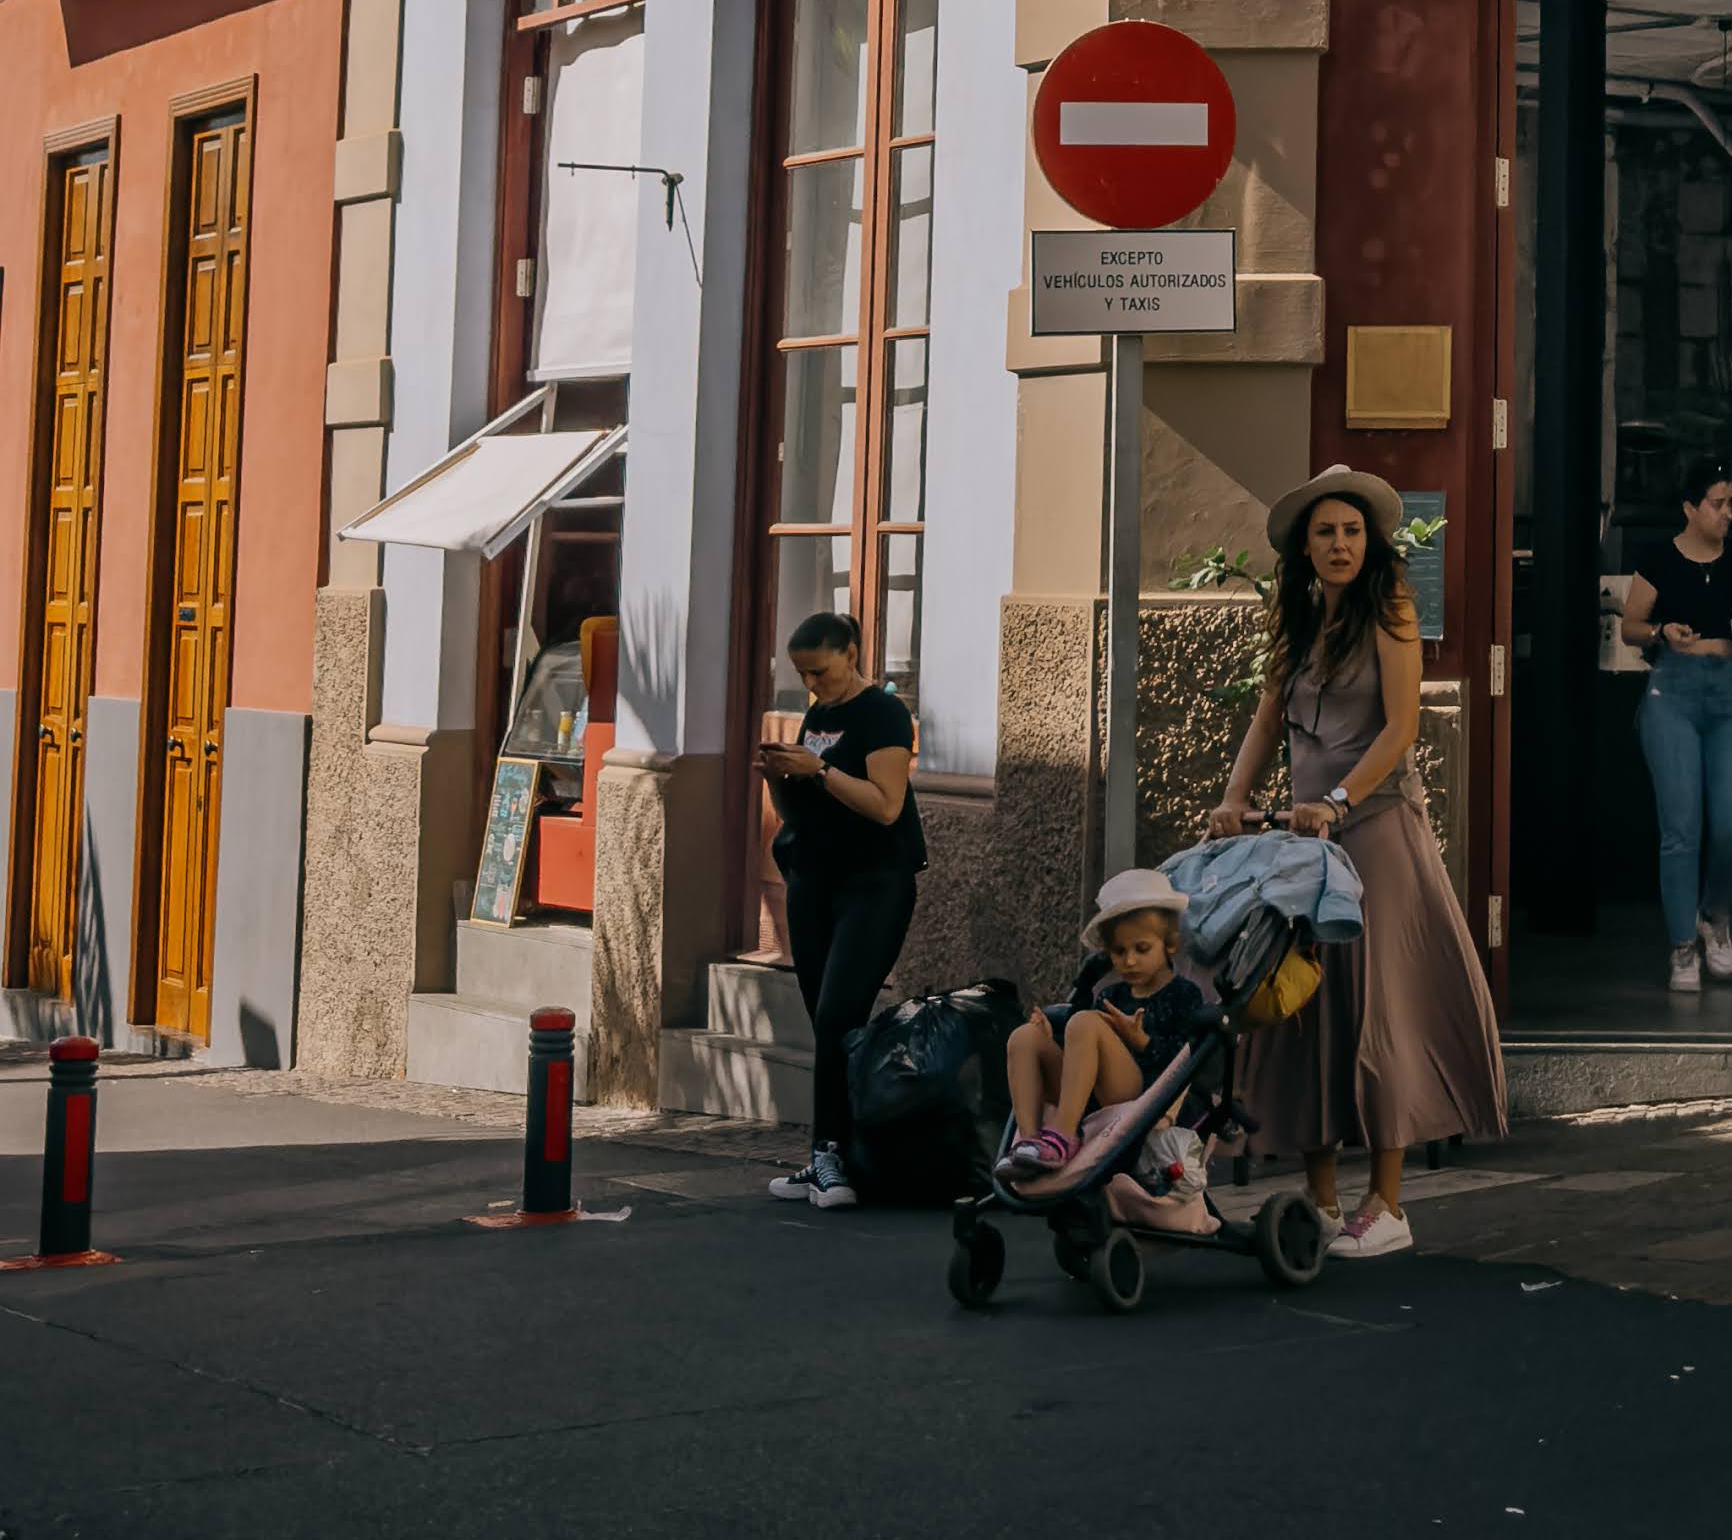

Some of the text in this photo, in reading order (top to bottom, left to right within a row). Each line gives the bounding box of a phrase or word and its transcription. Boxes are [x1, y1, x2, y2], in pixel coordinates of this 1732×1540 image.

[1100, 250, 1164, 266] EXCEPTO
[1042, 270, 1227, 290] VEHÍCULOS AUTORIZADOS
[1103, 296, 1161, 312] Y TAXIS
